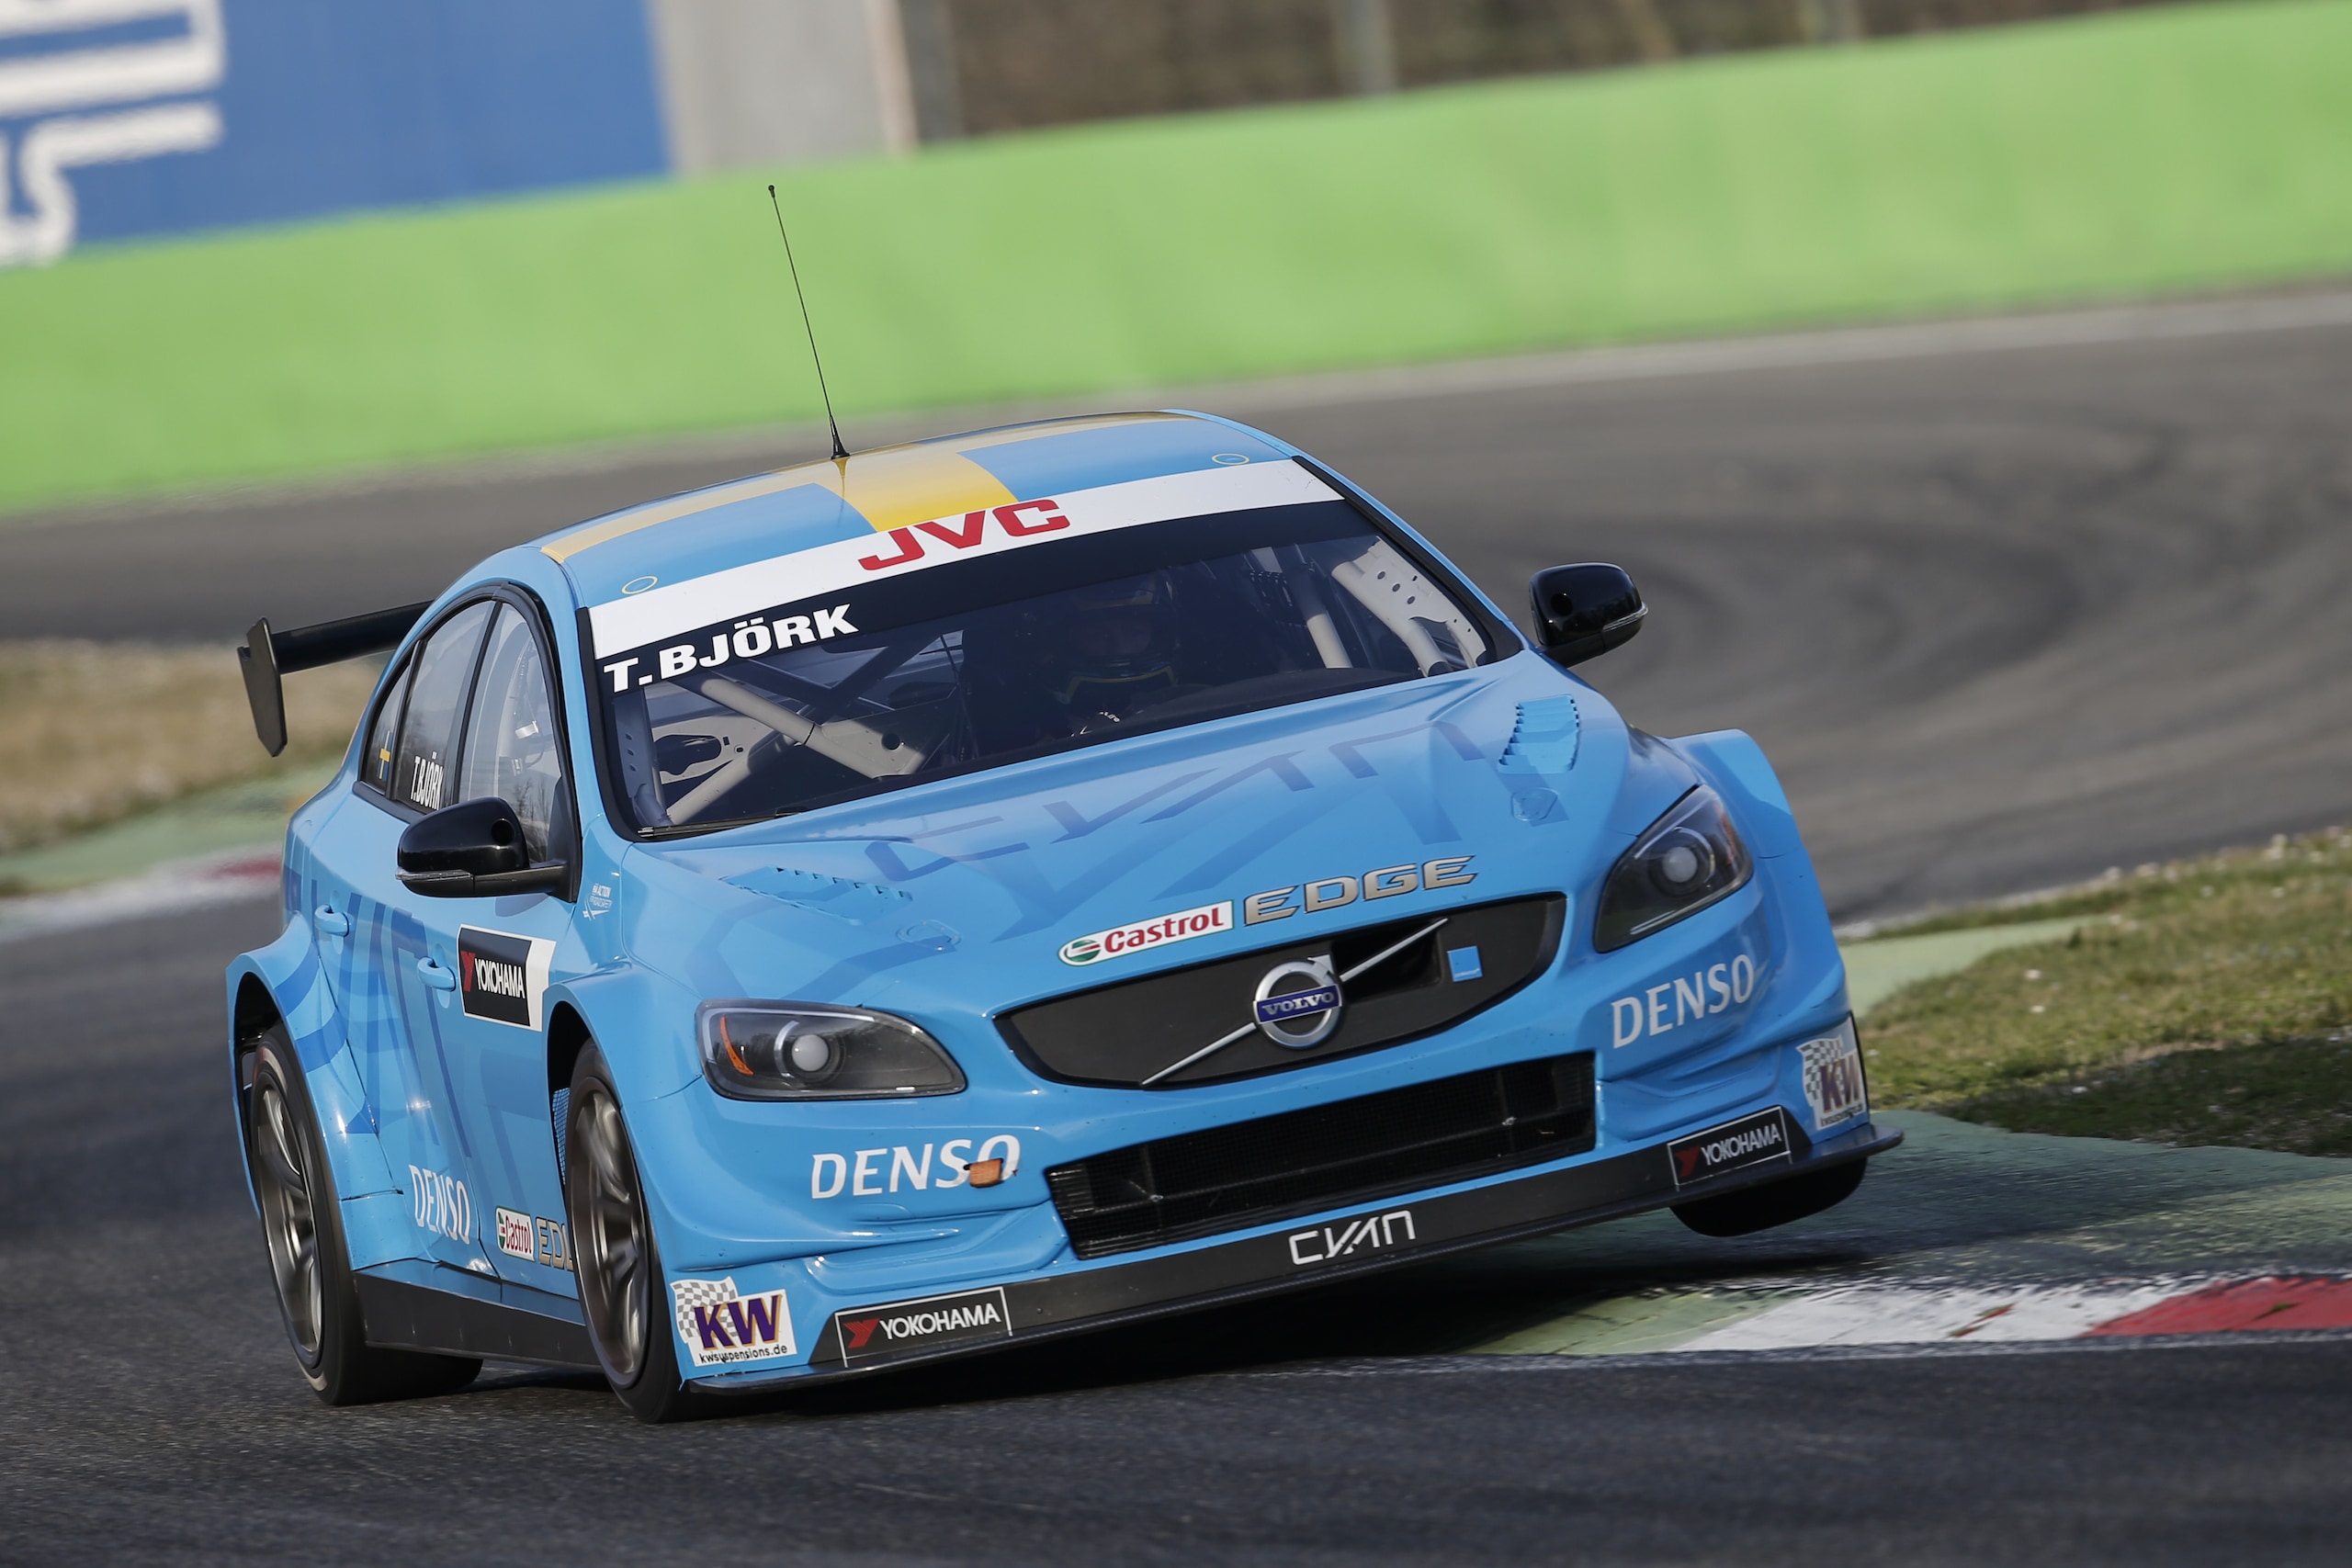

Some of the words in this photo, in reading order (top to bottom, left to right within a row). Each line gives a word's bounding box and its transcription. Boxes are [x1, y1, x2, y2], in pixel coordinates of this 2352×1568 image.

[857, 499, 1070, 571] JVC
[1104, 908, 1224, 953] Castrol
[1244, 855, 1478, 927] EDGE
[474, 957, 526, 998] YOKOHAMA
[1261, 992, 1335, 1015] VOLVO
[1611, 954, 1754, 1049] DENSO
[1819, 1054, 1860, 1113] KW
[811, 1134, 1021, 1200] DENSO
[1701, 1123, 1782, 1167] YOKOHAMA
[409, 1165, 470, 1245] DENSO
[505, 1215, 532, 1254] Castrol
[694, 1294, 783, 1350] KW
[879, 1303, 1001, 1340] YOKOHAMA
[699, 1345, 787, 1364] kwsuspensions.de
